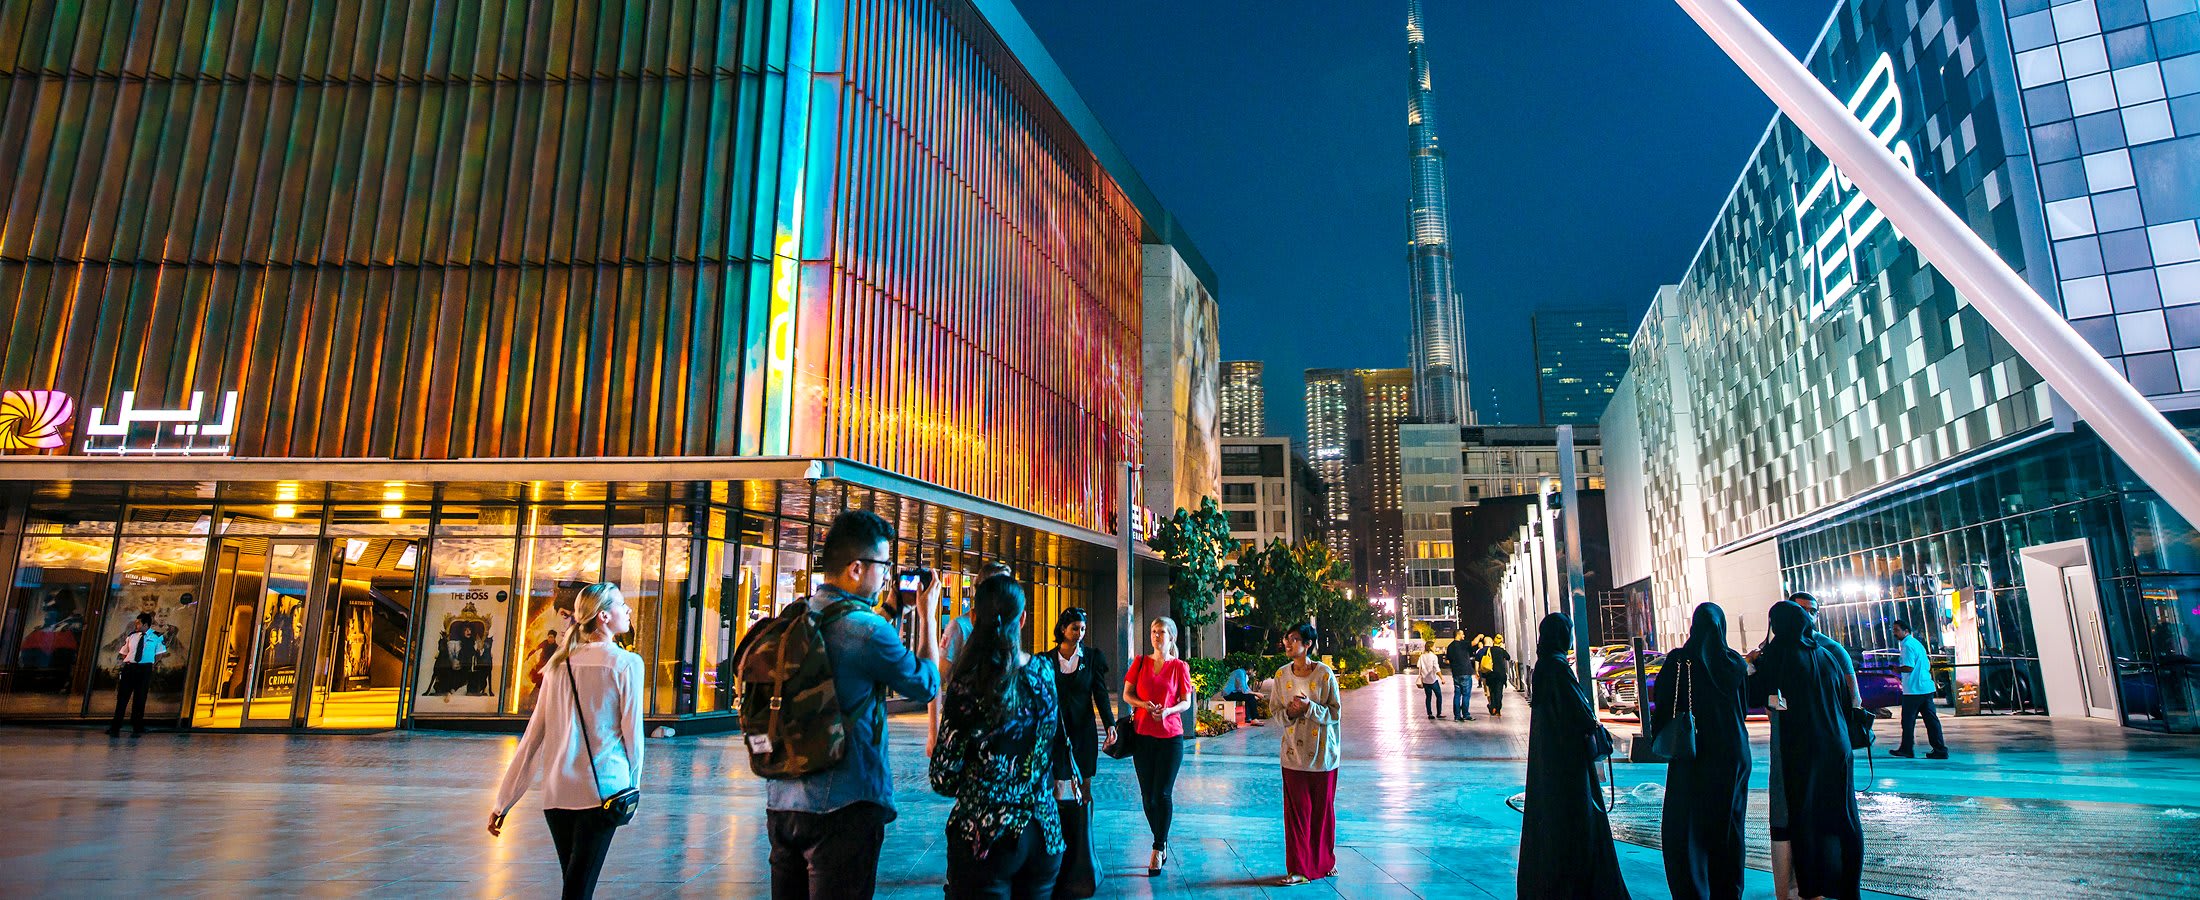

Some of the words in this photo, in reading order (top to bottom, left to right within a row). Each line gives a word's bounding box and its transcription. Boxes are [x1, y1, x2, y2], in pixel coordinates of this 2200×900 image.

[1791, 51, 1902, 248] HB
[87, 391, 238, 435] ريل
[451, 592, 464, 600] THE
[465, 592, 489, 600] BOSS
[268, 675, 296, 686] CRIMIN
